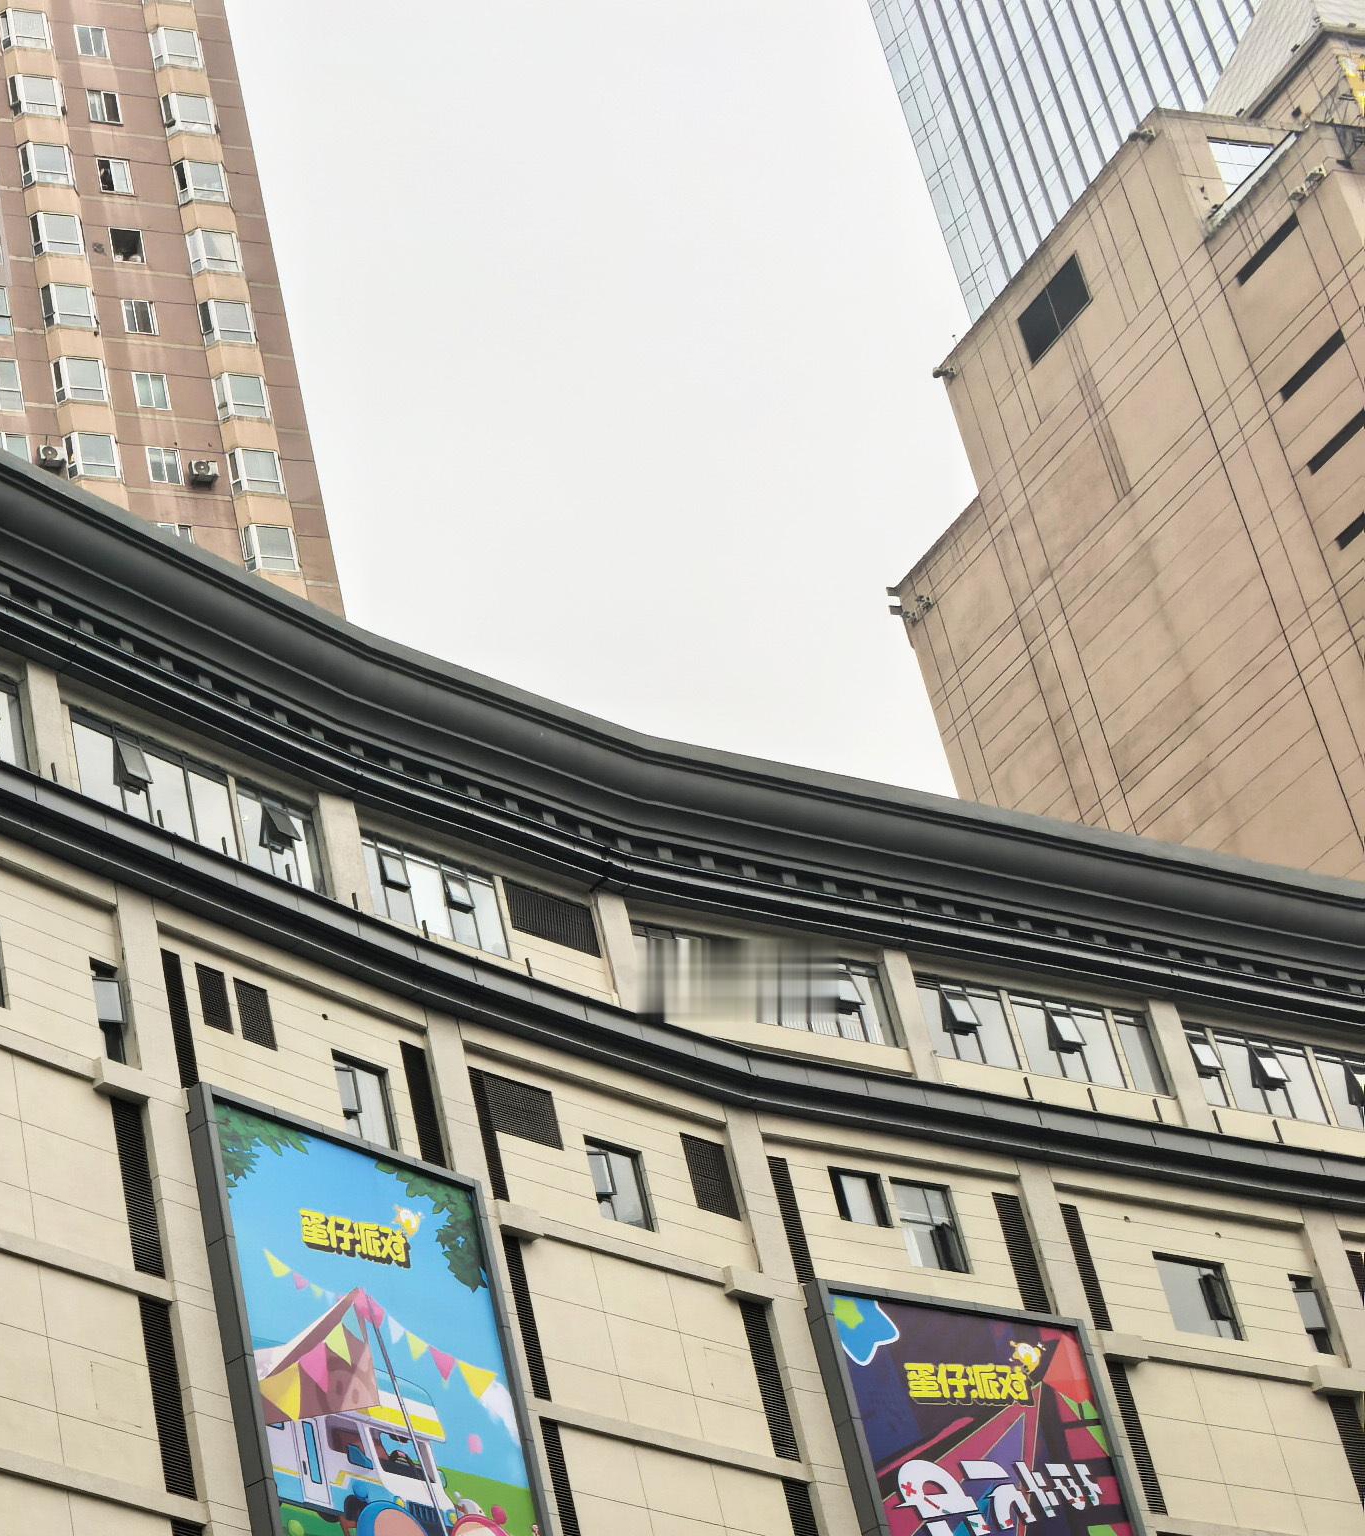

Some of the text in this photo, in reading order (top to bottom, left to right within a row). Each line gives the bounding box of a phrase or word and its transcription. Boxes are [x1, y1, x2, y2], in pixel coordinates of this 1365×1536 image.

[298, 1207, 411, 1268] 蛋仔派对
[903, 1362, 1034, 1406] 蛋仔派对
